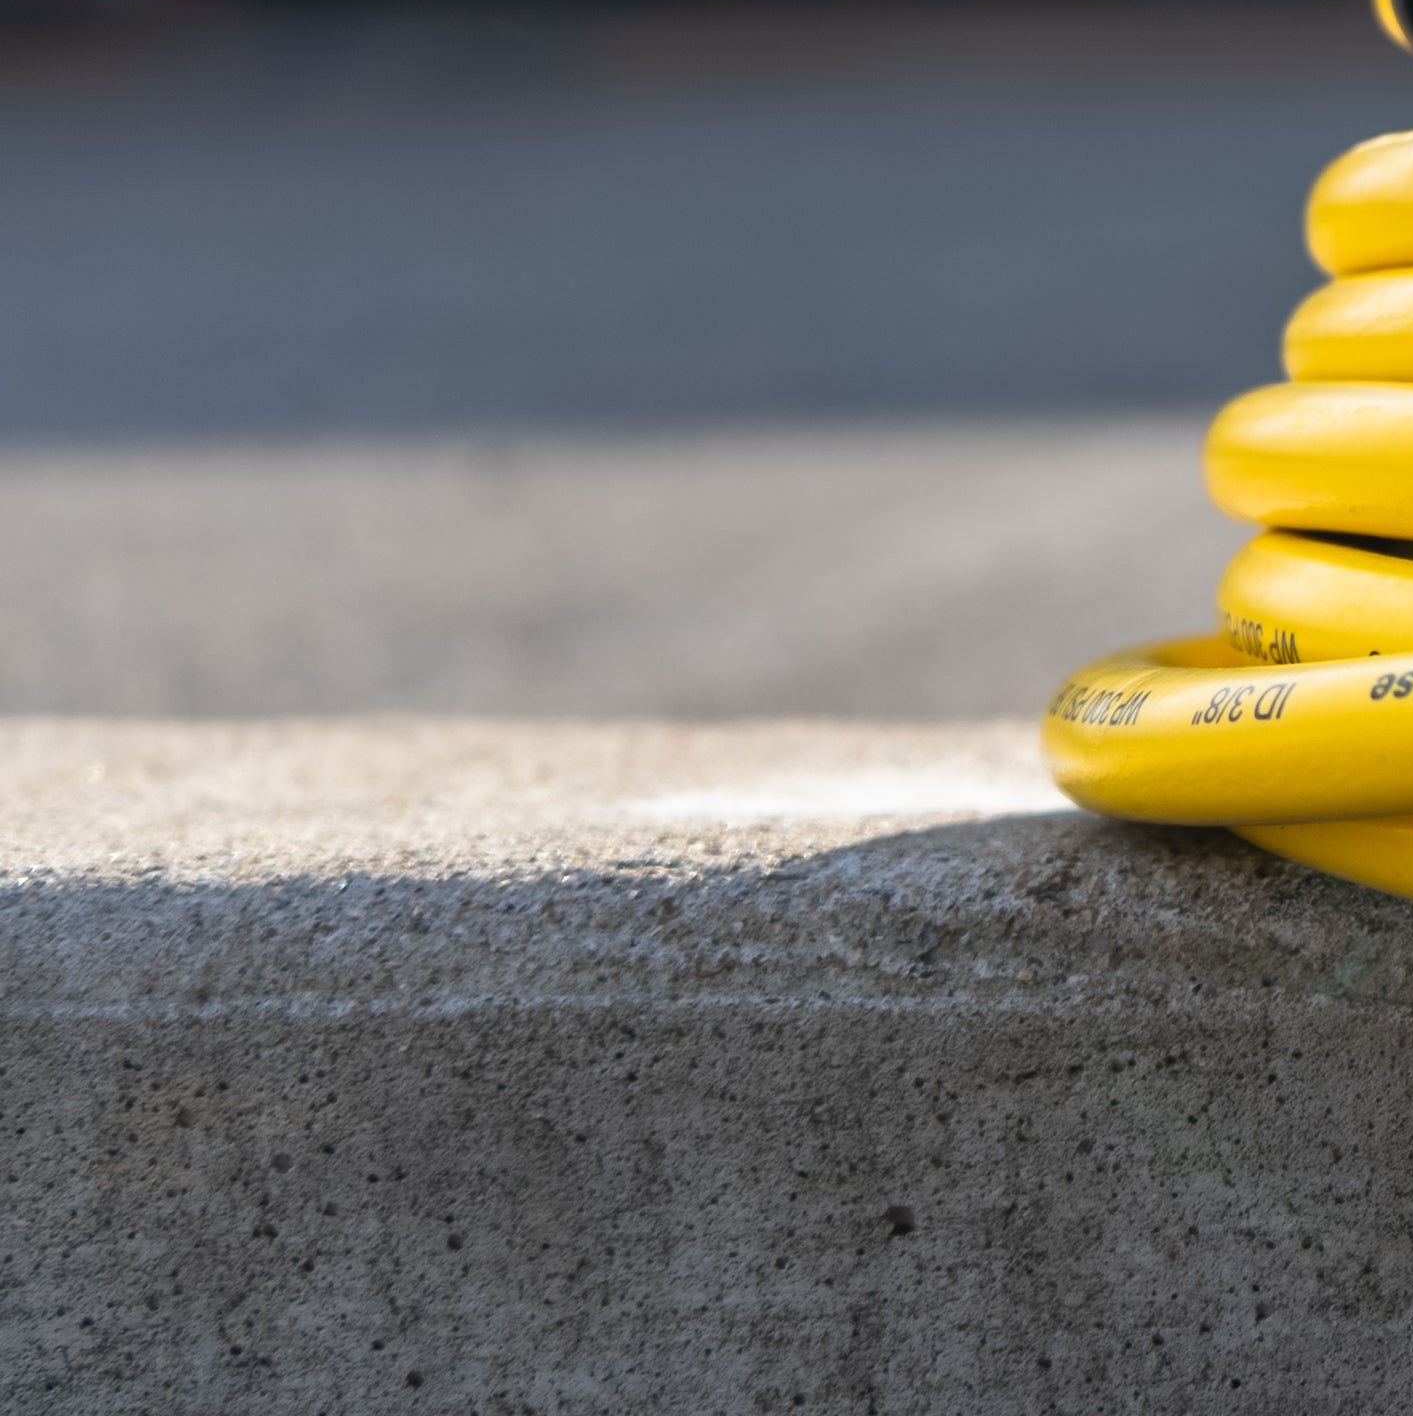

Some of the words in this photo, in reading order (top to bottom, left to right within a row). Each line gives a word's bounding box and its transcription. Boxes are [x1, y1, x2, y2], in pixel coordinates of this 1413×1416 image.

[1269, 628, 1301, 665] WP
[1109, 690, 1152, 725] WP
[1191, 685, 1255, 726] 3/8"
[1252, 682, 1298, 721] ID
